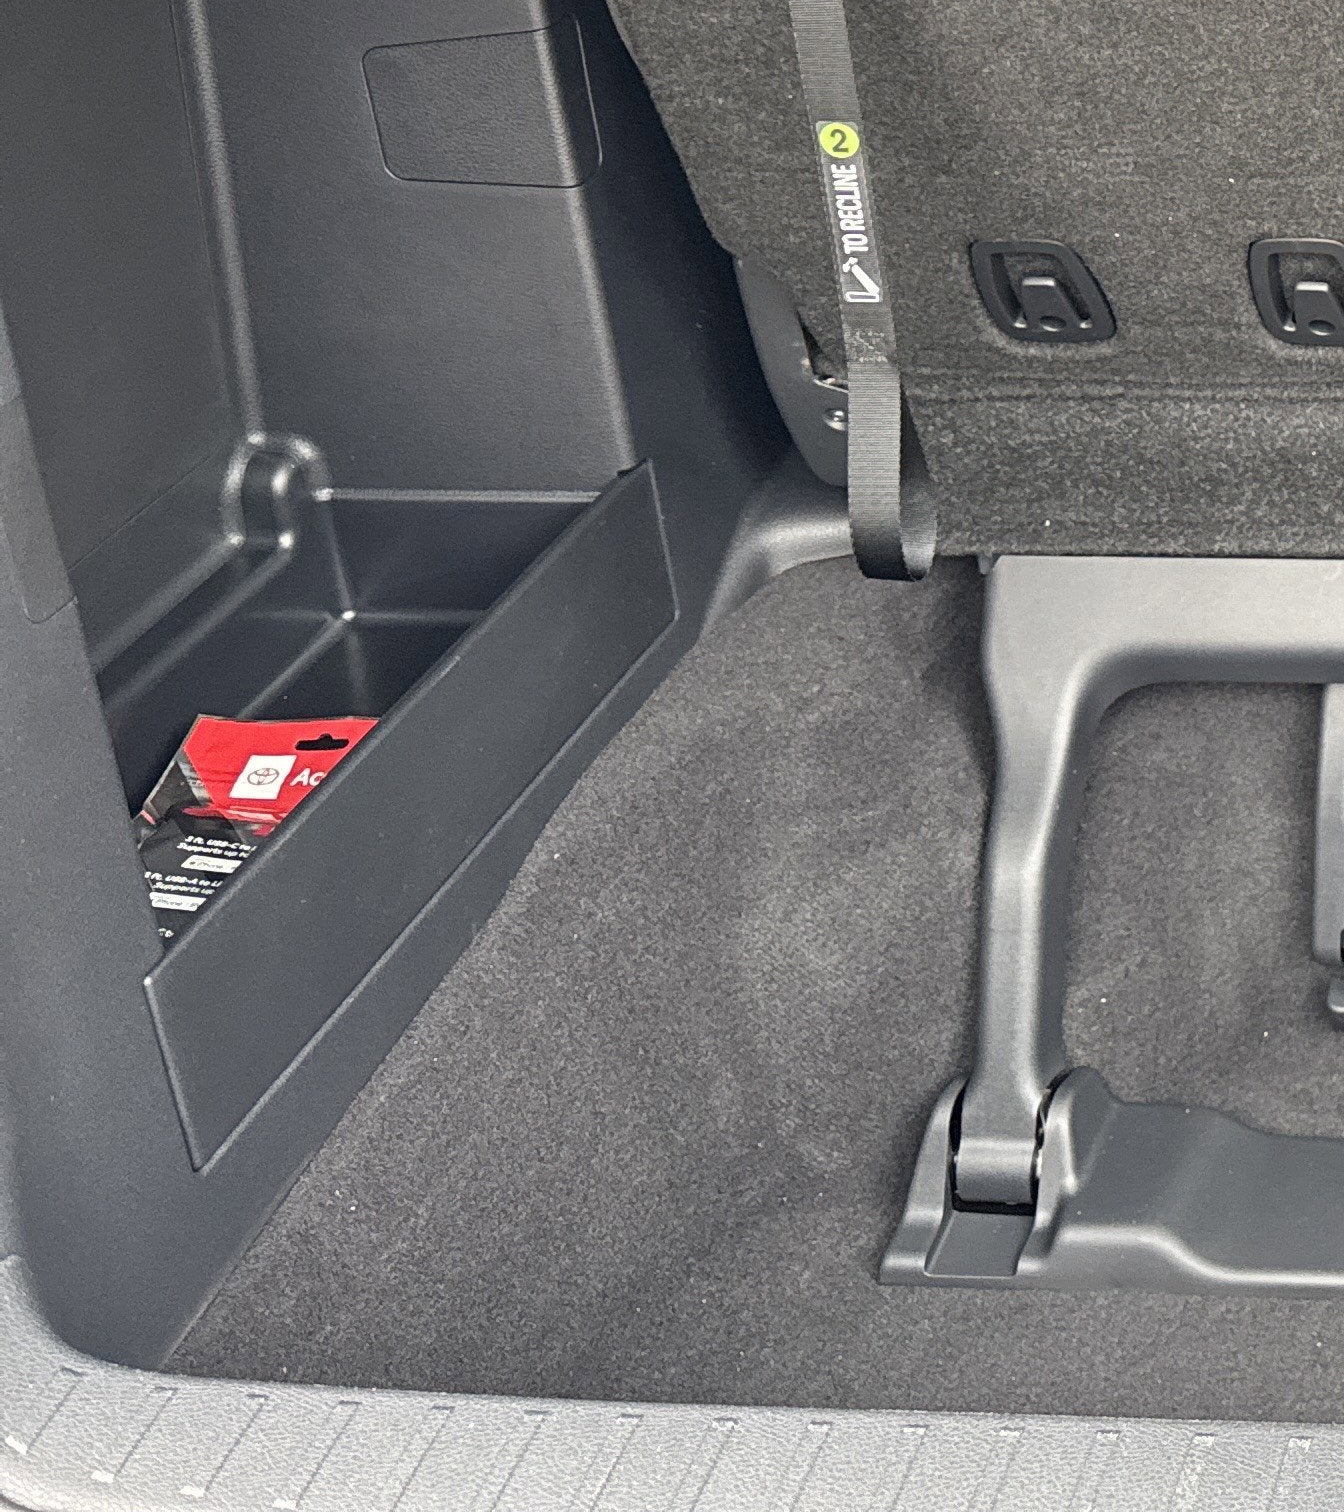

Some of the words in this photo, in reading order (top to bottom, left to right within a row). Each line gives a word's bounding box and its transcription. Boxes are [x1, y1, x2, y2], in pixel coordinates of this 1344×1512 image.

[829, 128, 850, 153] 2
[830, 163, 866, 231] RECLINE
[840, 233, 869, 255] TO
